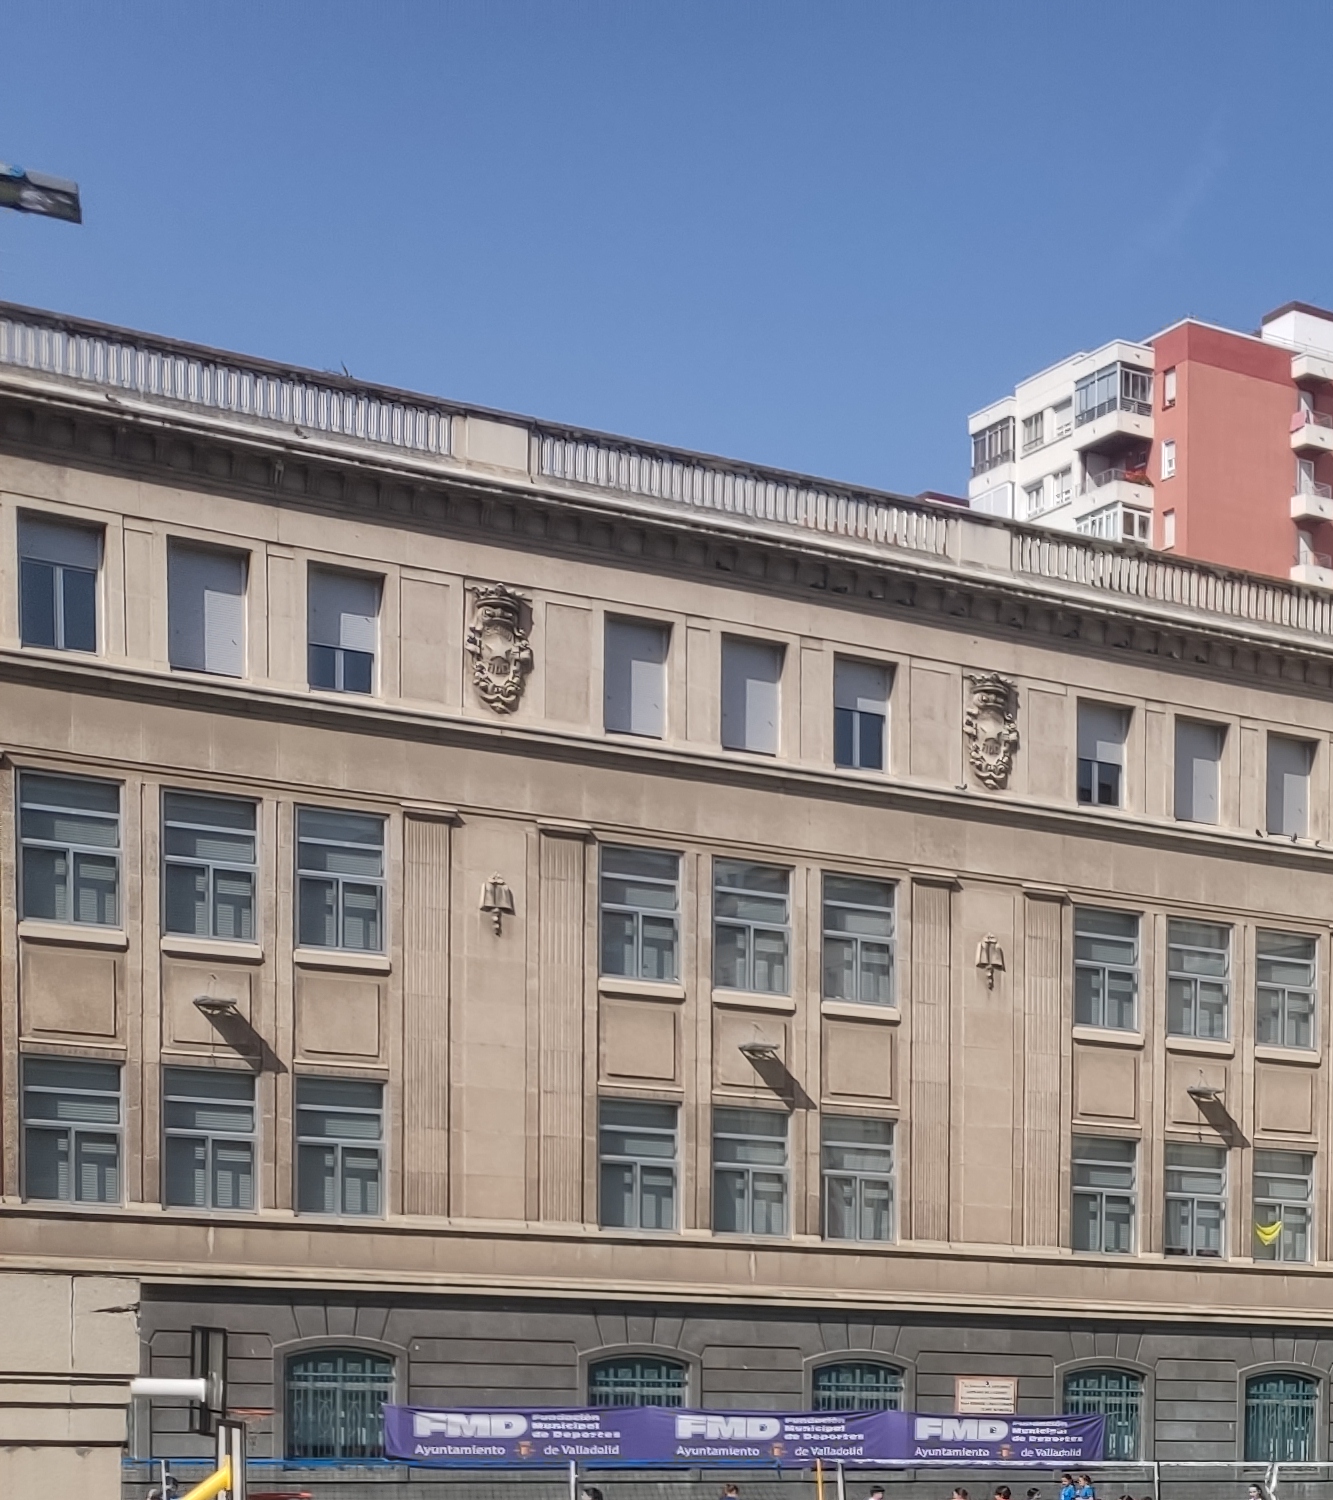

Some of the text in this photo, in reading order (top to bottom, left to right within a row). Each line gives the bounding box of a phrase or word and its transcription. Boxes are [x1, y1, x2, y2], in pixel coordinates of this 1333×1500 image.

[413, 1412, 528, 1438] FMD
[675, 1415, 780, 1439] FMD
[784, 1425, 845, 1433] Municipal
[915, 1417, 1009, 1441] FMD
[553, 1431, 620, 1439] Deportes
[804, 1433, 864, 1441] Deportes
[414, 1444, 619, 1456] Ayuntamiento de Valladolid
[676, 1446, 863, 1457] Ayuntamiento de Valladolid
[915, 1447, 1081, 1457] Ayuntamiento de Valladolid
